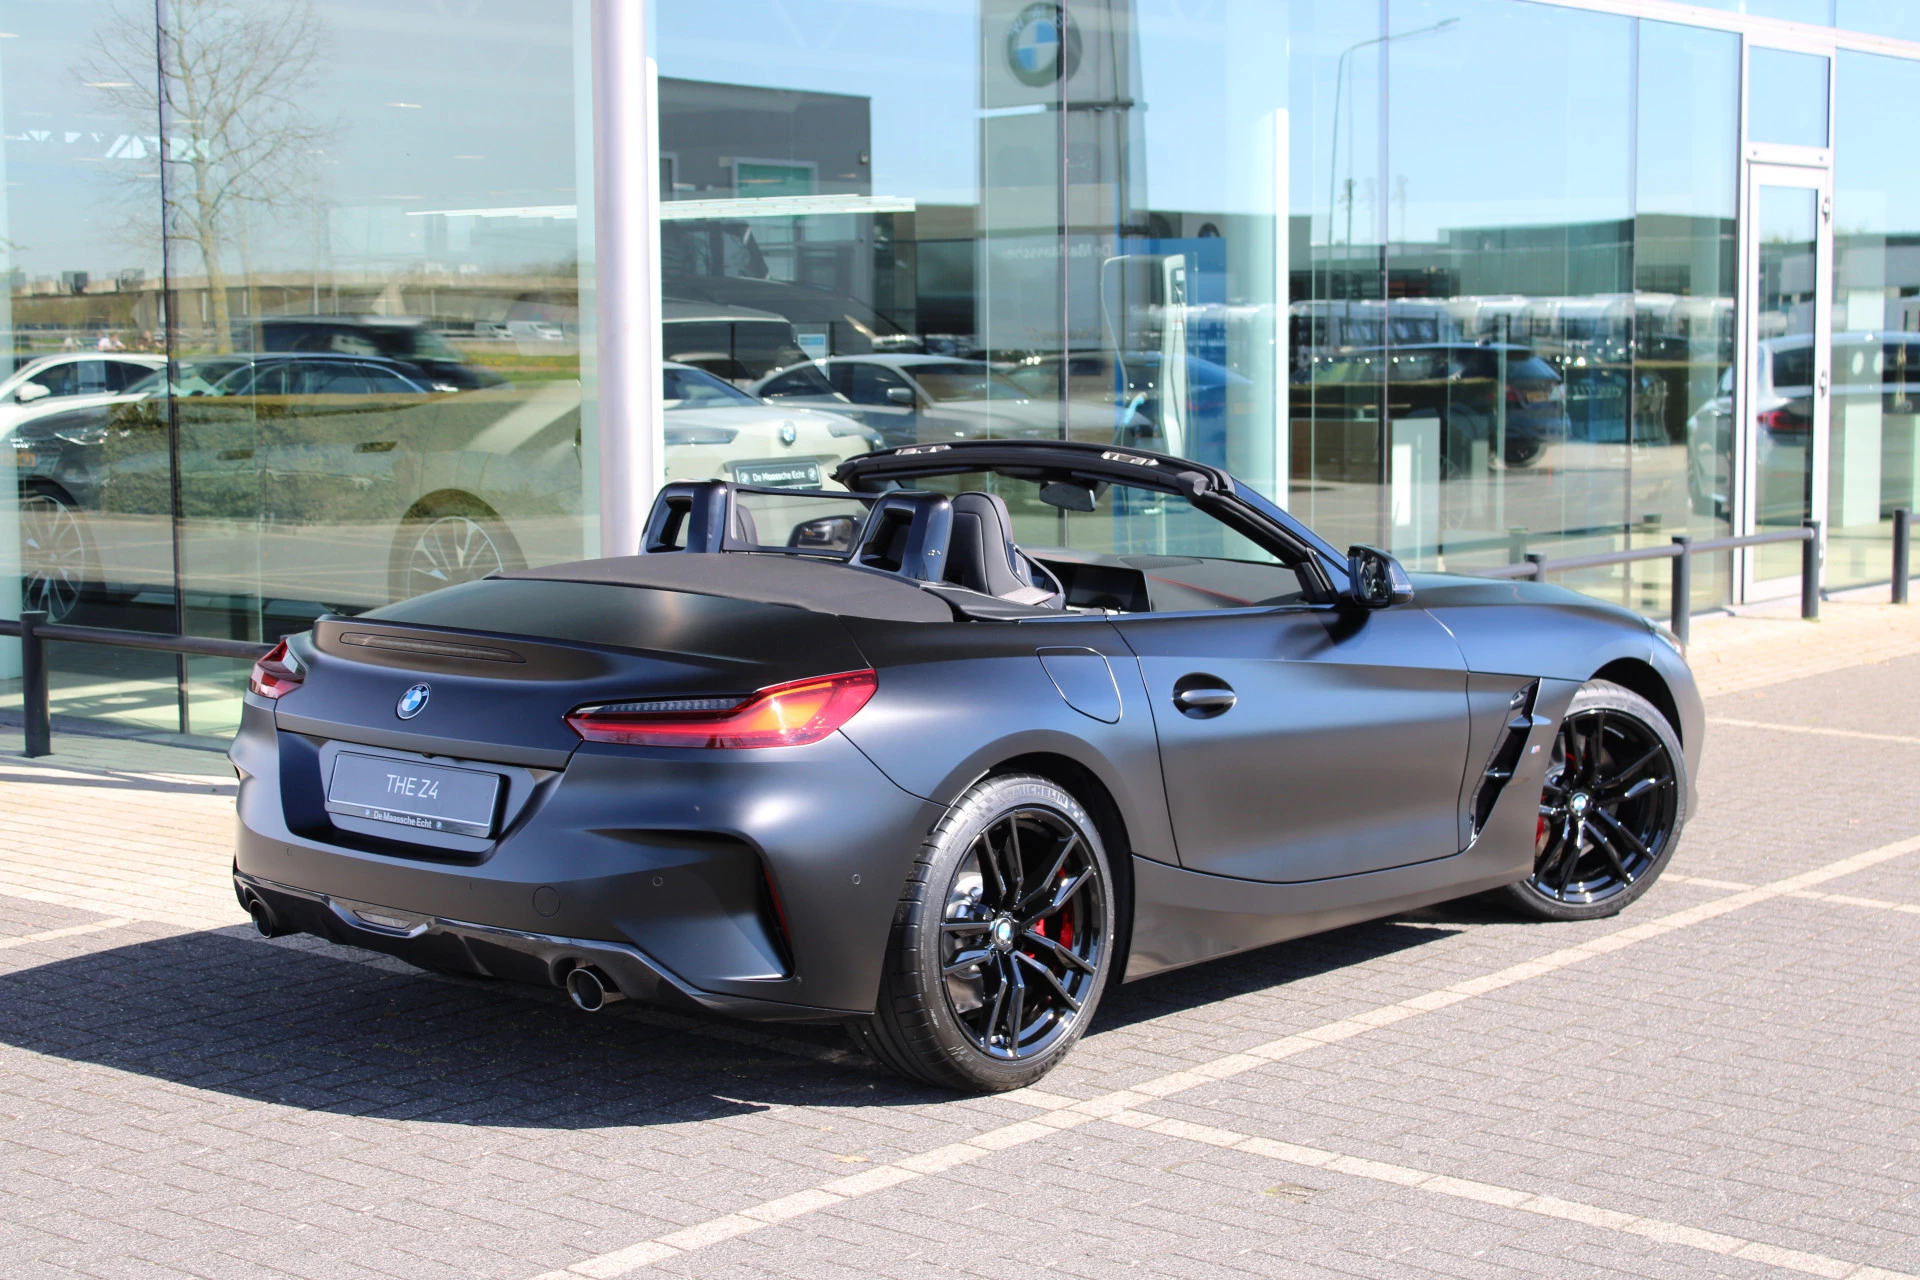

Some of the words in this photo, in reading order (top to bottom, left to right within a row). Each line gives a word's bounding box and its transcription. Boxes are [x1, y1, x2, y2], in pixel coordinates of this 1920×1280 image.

[752, 473, 762, 482] De
[386, 773, 418, 796] THE
[417, 779, 440, 800] Z4
[1012, 784, 1068, 808] MICHELIN
[373, 810, 382, 820] De
[382, 811, 416, 826] Maassche
[416, 817, 433, 829] Echt
